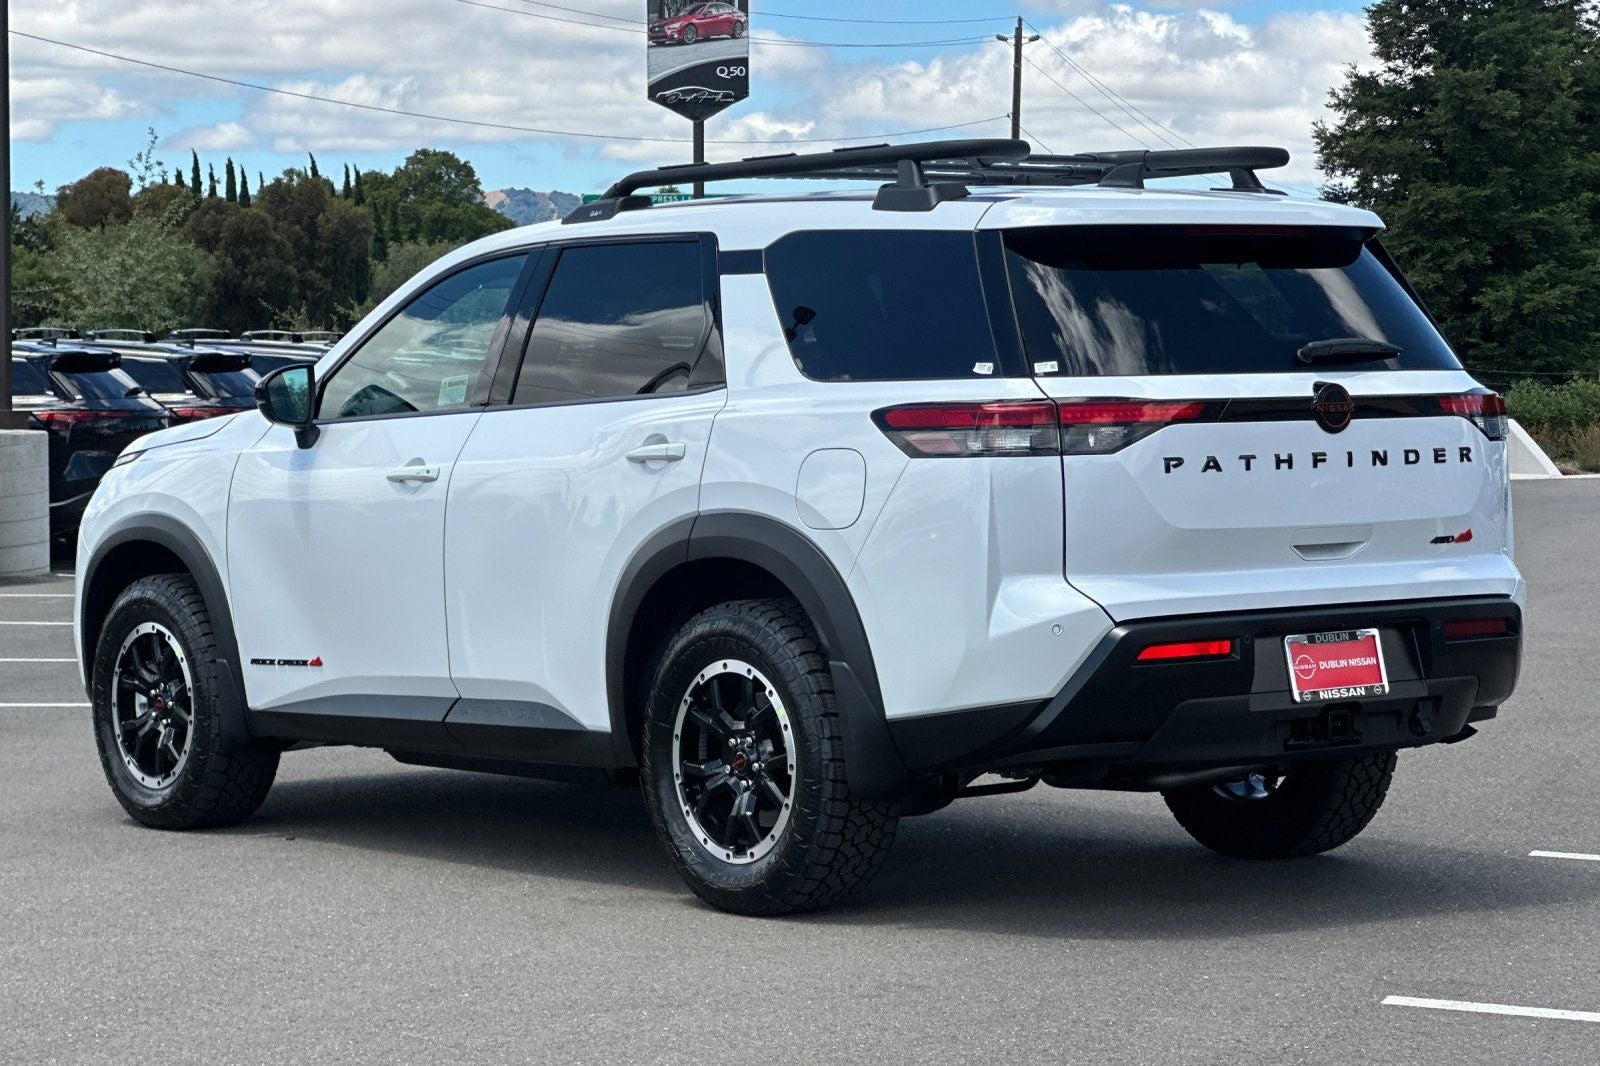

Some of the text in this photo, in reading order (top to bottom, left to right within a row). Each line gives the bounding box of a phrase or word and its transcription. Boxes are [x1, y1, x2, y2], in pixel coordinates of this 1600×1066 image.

[716, 66, 746, 79] Q50
[1163, 446, 1473, 474] PATHFINDER
[1315, 632, 1350, 643] DUBLIN
[1294, 663, 1317, 671] NISSAN
[1319, 656, 1377, 670] DUBLIN NISSAN
[1319, 686, 1365, 699] NISSAN
